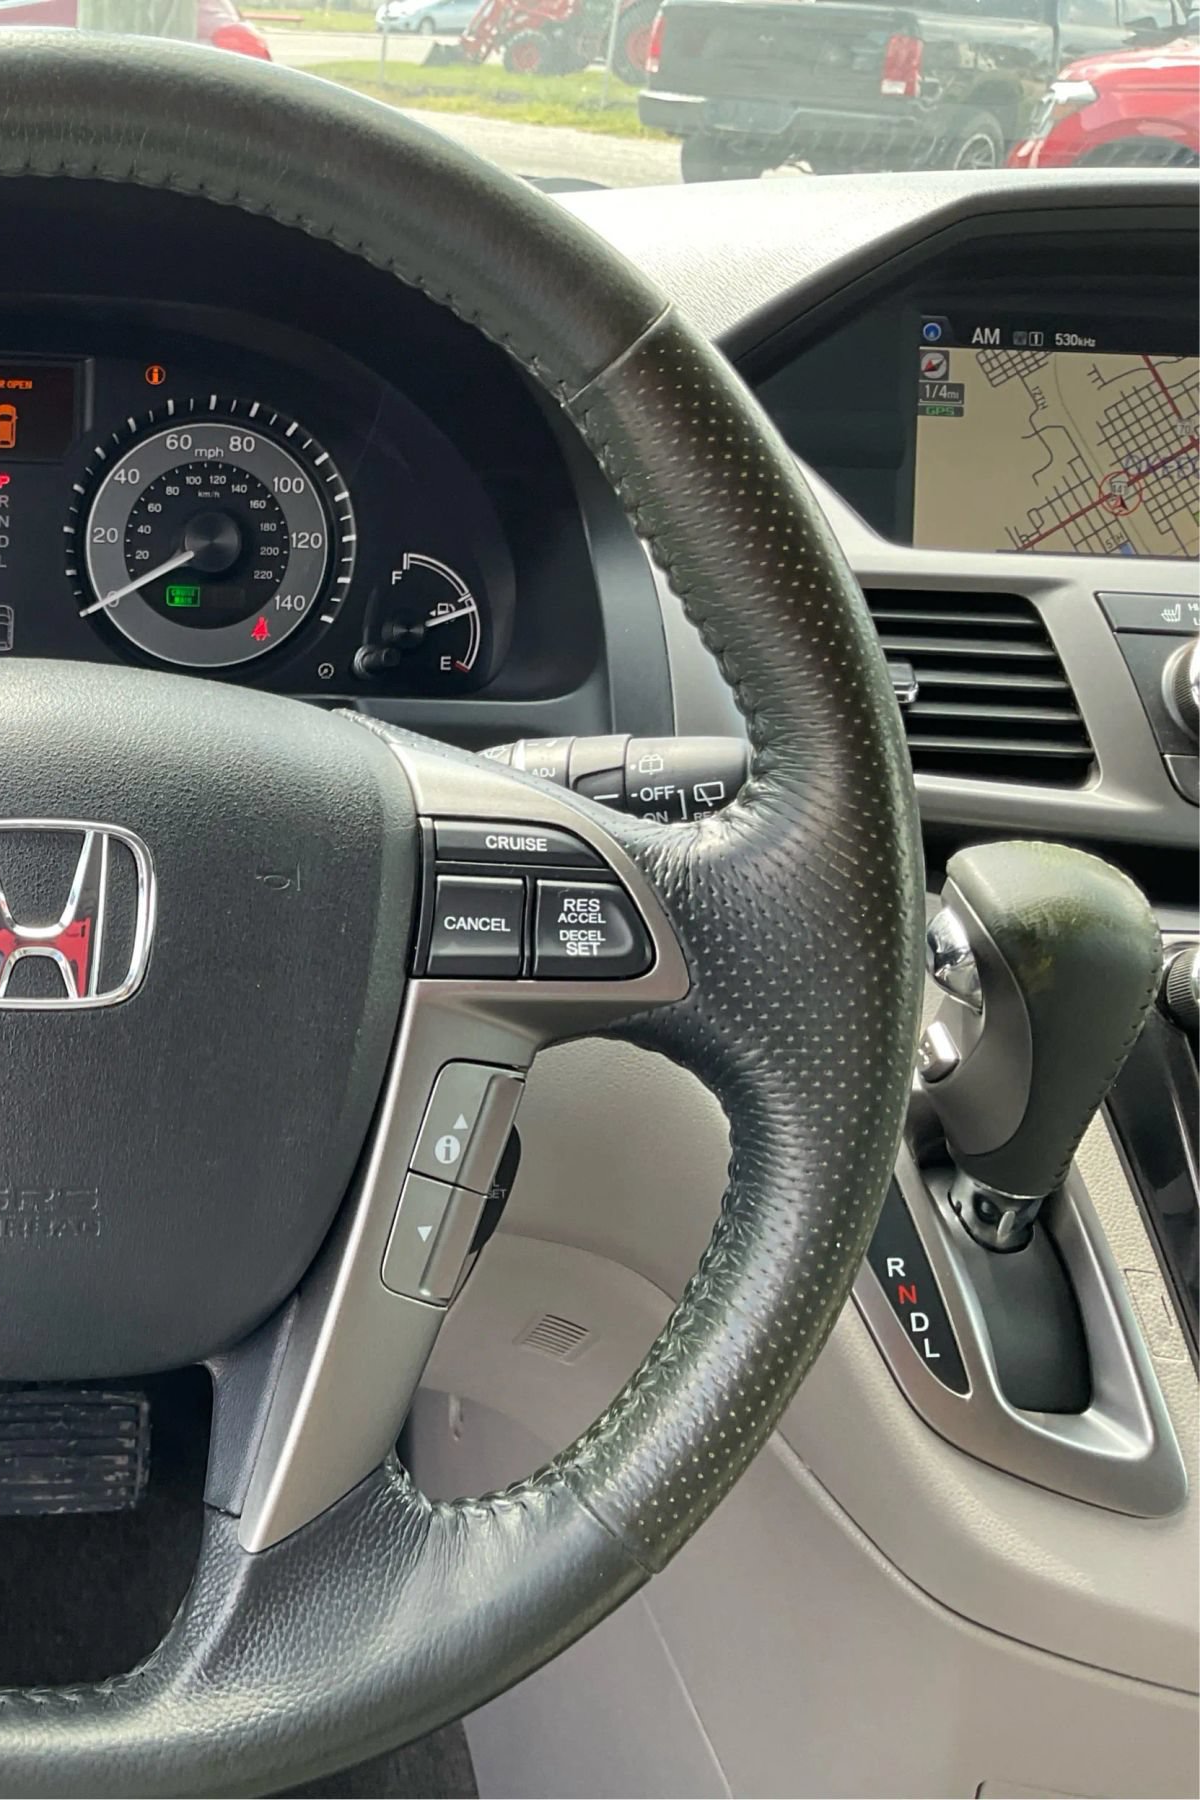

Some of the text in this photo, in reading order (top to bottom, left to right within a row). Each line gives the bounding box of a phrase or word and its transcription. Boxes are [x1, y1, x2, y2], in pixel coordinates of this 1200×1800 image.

[972, 327, 1001, 345] AM
[7, 380, 33, 390] OPEN
[925, 406, 955, 416] GPS
[165, 434, 193, 450] 60
[228, 436, 256, 453] 80
[194, 448, 224, 458] mph
[113, 467, 140, 485] 40
[185, 475, 202, 485] 100
[209, 475, 227, 485] 120
[165, 485, 180, 497] 80
[231, 483, 248, 494] 140
[272, 476, 305, 494] 100
[147, 502, 162, 514] 60
[249, 499, 266, 511] 160
[137, 523, 152, 535] 40
[260, 522, 277, 533] 180
[93, 527, 118, 544] 20
[290, 532, 323, 549] 120
[135, 549, 149, 561] 20
[260, 546, 279, 556] 200
[254, 570, 273, 581] 220
[392, 571, 402, 585] F
[274, 594, 306, 612] 140
[440, 656, 452, 671] E
[531, 767, 556, 778] ADJ
[639, 785, 675, 802] OFF
[485, 835, 548, 852] CRUISE
[563, 898, 600, 912] RES
[443, 916, 511, 932] CANCEL
[557, 912, 607, 924] ACCEL
[558, 930, 606, 942] DECEL
[566, 942, 601, 956] SET
[886, 1257, 906, 1278] R
[898, 1284, 917, 1305] N
[910, 1312, 929, 1332] D
[924, 1338, 940, 1358] L
